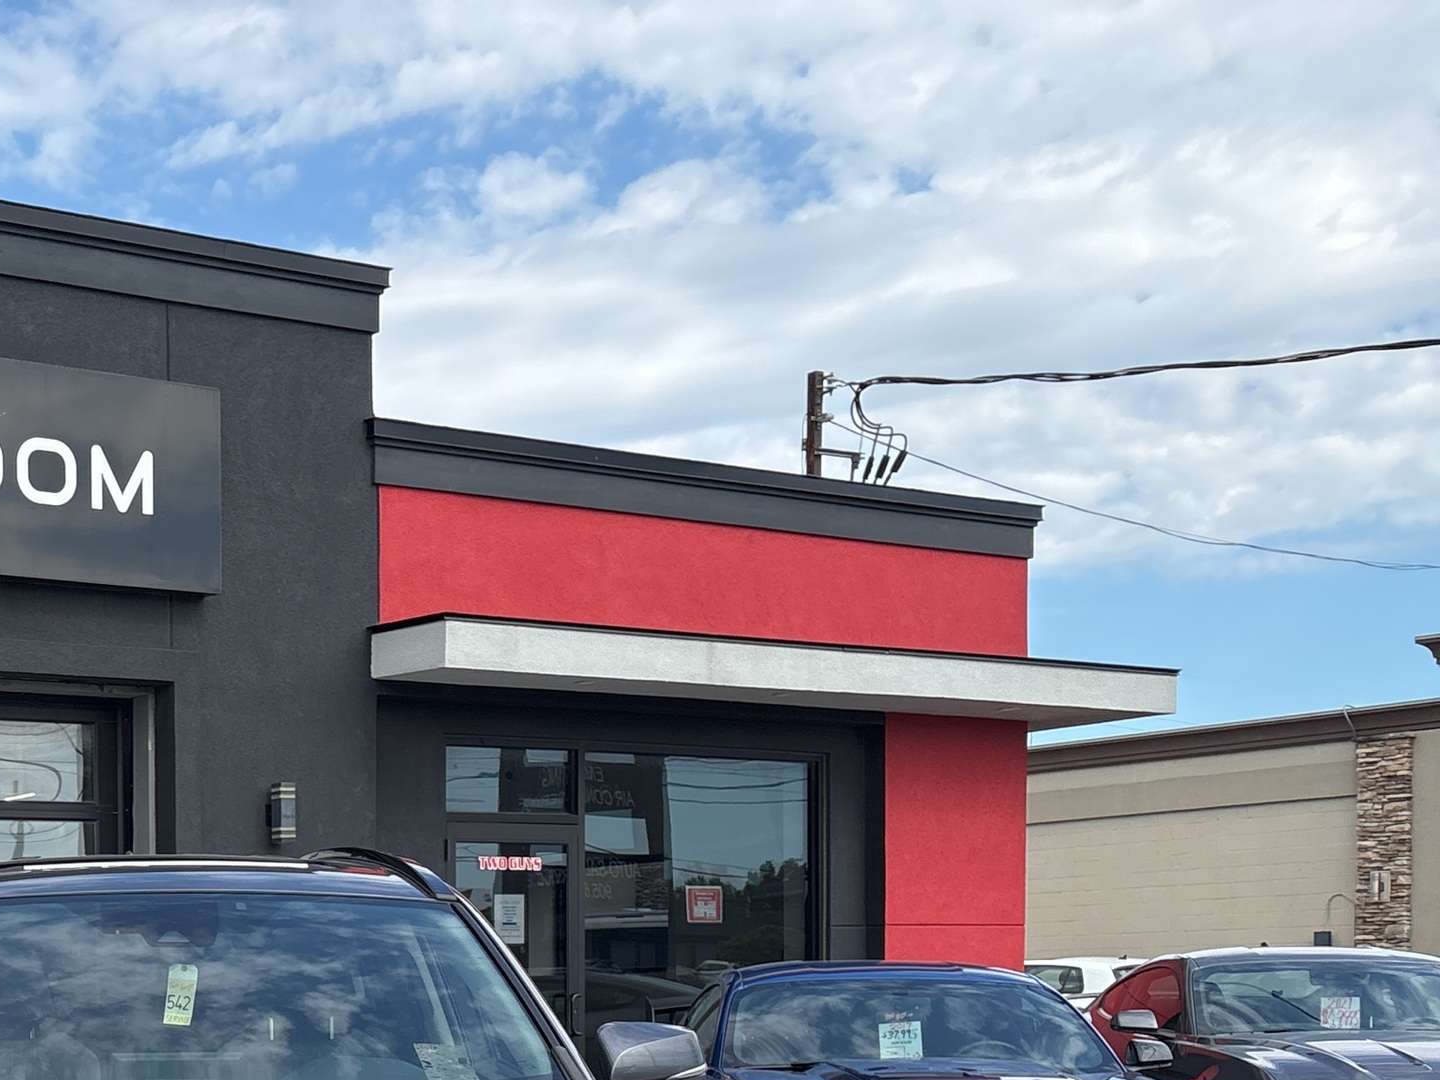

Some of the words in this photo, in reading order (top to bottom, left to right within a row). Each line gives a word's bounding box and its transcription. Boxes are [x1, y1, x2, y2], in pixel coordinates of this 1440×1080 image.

[478, 856, 507, 871] TWO
[508, 856, 543, 872] GUYS
[166, 994, 192, 1011] 542
